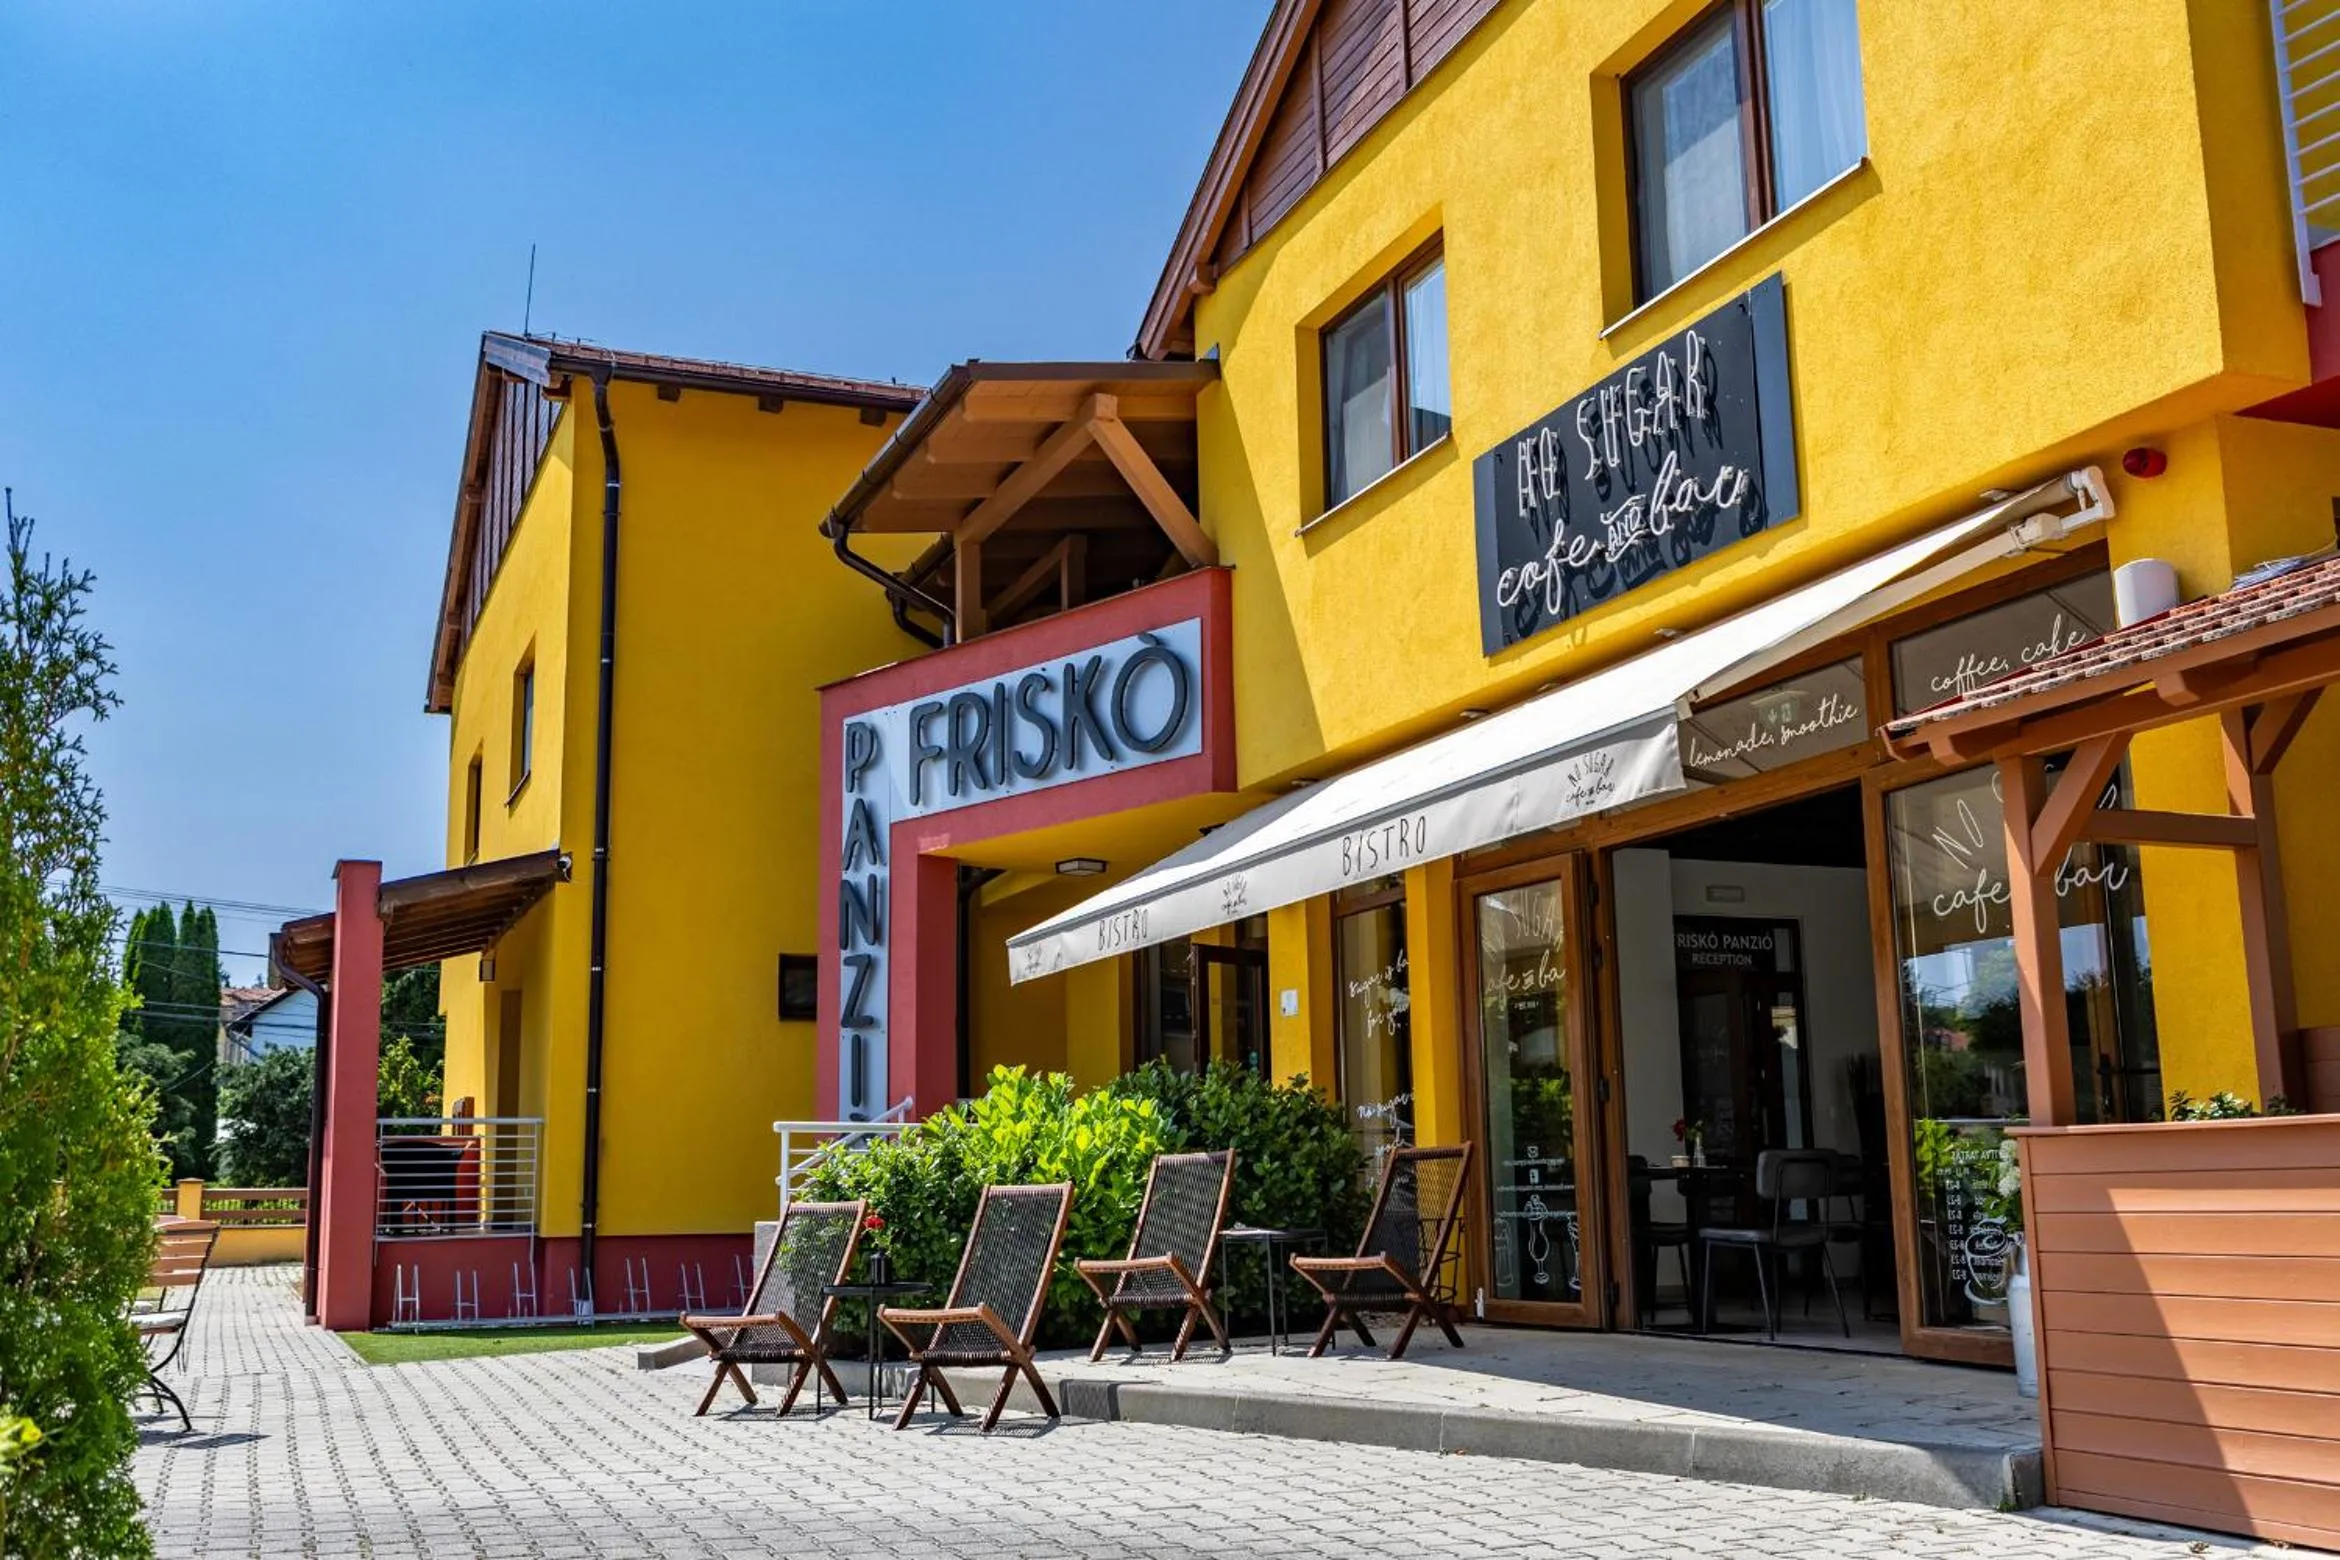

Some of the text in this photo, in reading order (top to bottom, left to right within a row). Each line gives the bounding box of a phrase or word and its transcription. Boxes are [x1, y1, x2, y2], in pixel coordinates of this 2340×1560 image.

[1518, 330, 1705, 517] NO SUGAR
[1497, 518, 1600, 614] cafe
[1650, 450, 1749, 536] bar
[2021, 613, 2087, 661] cake
[1342, 815, 1426, 877] BISTRO
[1932, 798, 1984, 869] NO
[1933, 846, 2128, 934] cafe bar
[839, 720, 881, 1140] PANZI
[1098, 909, 1149, 952] BISTRO
[1692, 952, 1753, 966] RECEPTION
[1723, 931, 1773, 950] PANZIÓ
